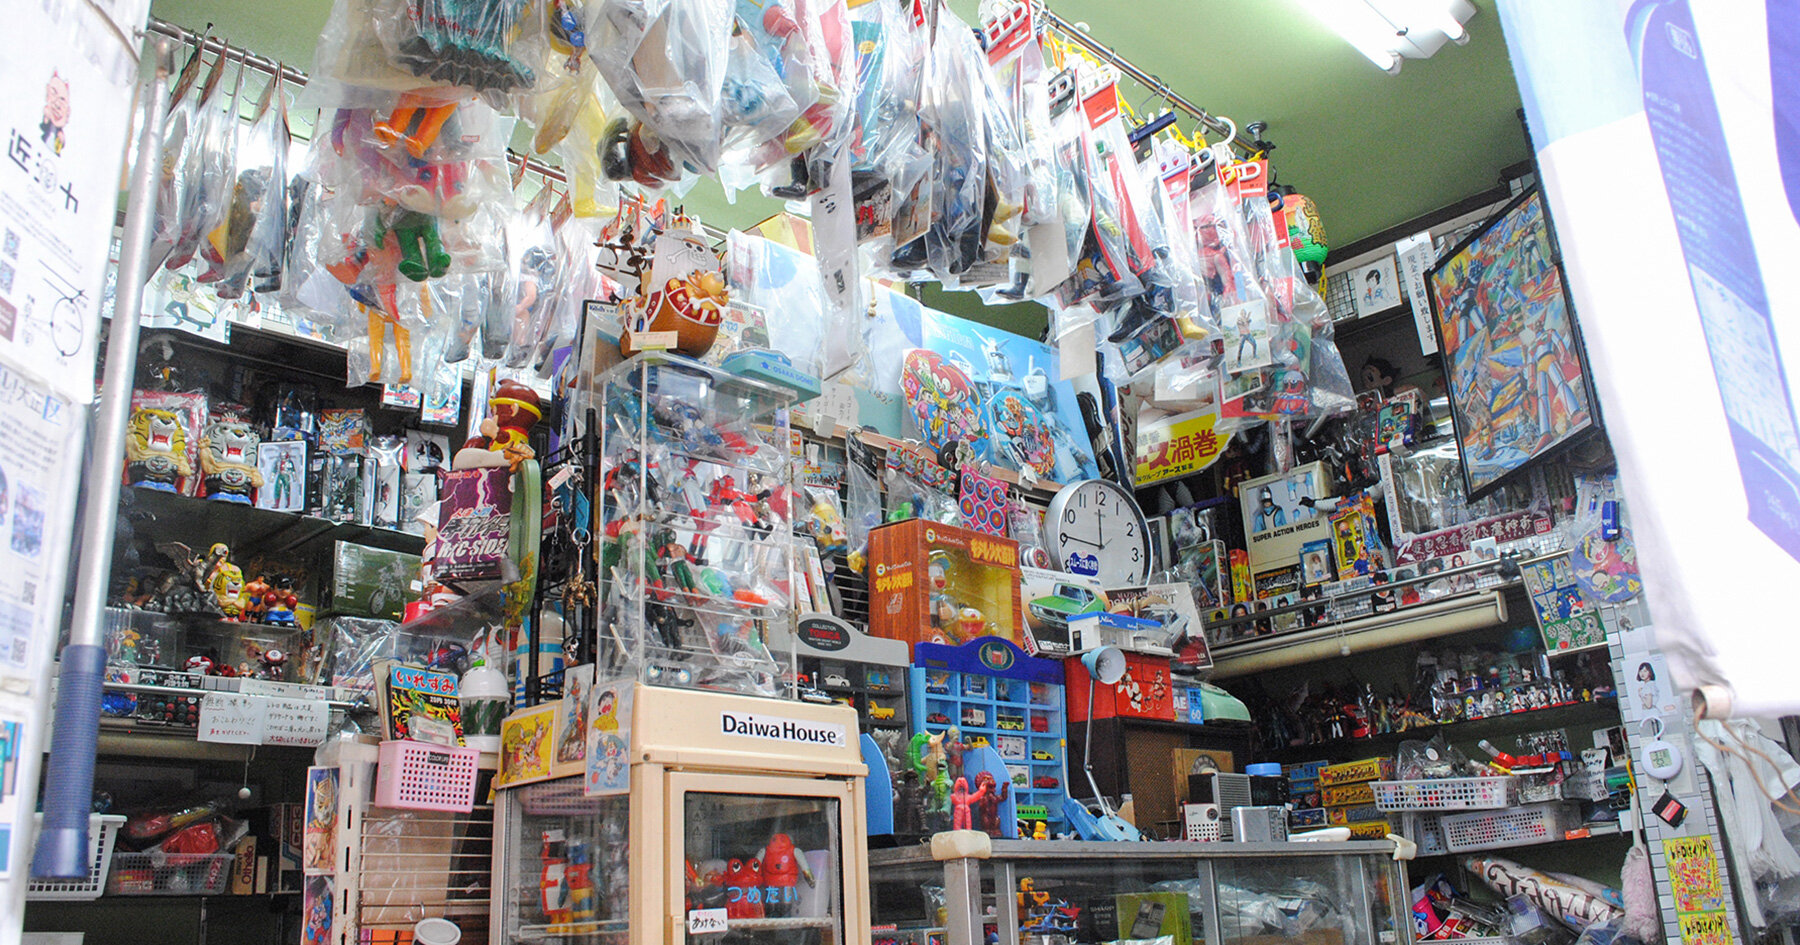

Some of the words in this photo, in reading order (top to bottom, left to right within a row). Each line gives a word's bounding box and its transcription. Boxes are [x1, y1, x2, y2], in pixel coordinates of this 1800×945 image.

[1078, 493, 1086, 508] 11
[1095, 490, 1106, 507] 12
[1064, 508, 1076, 524] 10
[1126, 522, 1134, 537] 2
[1252, 532, 1272, 543] SUPER
[1273, 526, 1294, 538] ACTION
[1296, 520, 1320, 532] HEROES
[1060, 532, 1068, 547] 9
[1131, 547, 1139, 562] 3
[1126, 572, 1134, 584] 4
[808, 628, 841, 640] TOMICA
[722, 714, 780, 738] Daiwa
[783, 722, 837, 744] House
[727, 885, 798, 903] つめたい
[1090, 905, 1115, 913] SHARP
[692, 916, 725, 930] あけない
